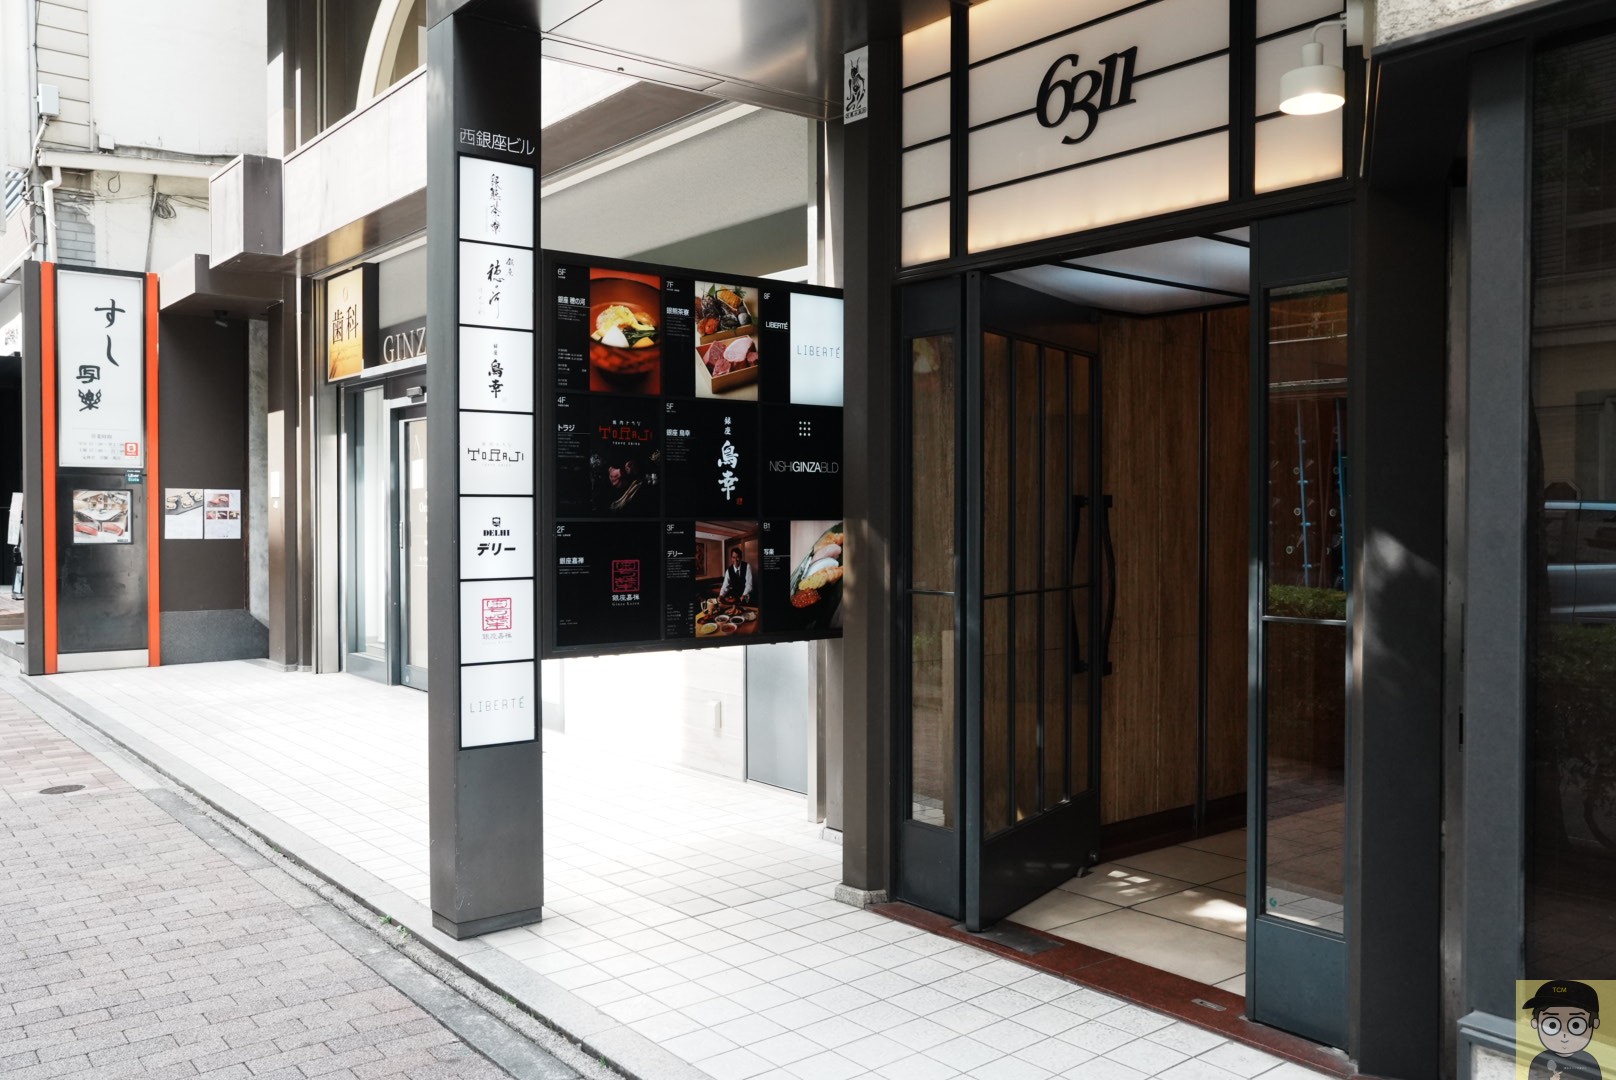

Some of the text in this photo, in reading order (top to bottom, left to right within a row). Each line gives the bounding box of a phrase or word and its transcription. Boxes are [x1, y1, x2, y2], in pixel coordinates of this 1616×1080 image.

[1036, 46, 1138, 145] 6311
[460, 128, 535, 155] 西銀座ビル
[557, 268, 566, 276] 6F
[332, 304, 359, 344] 歯科
[765, 321, 788, 330] LIBERTÉ
[94, 298, 126, 367] すし
[797, 344, 841, 359] LIBERTÉ
[558, 424, 575, 432] トラジ
[467, 448, 524, 462] TORAJI
[717, 440, 739, 500] 鳥幸
[556, 525, 565, 534] 2F
[763, 522, 771, 530] B1
[477, 543, 516, 556] デリー
[667, 550, 684, 558] デリー
[469, 696, 524, 713] LIBERTÉ
